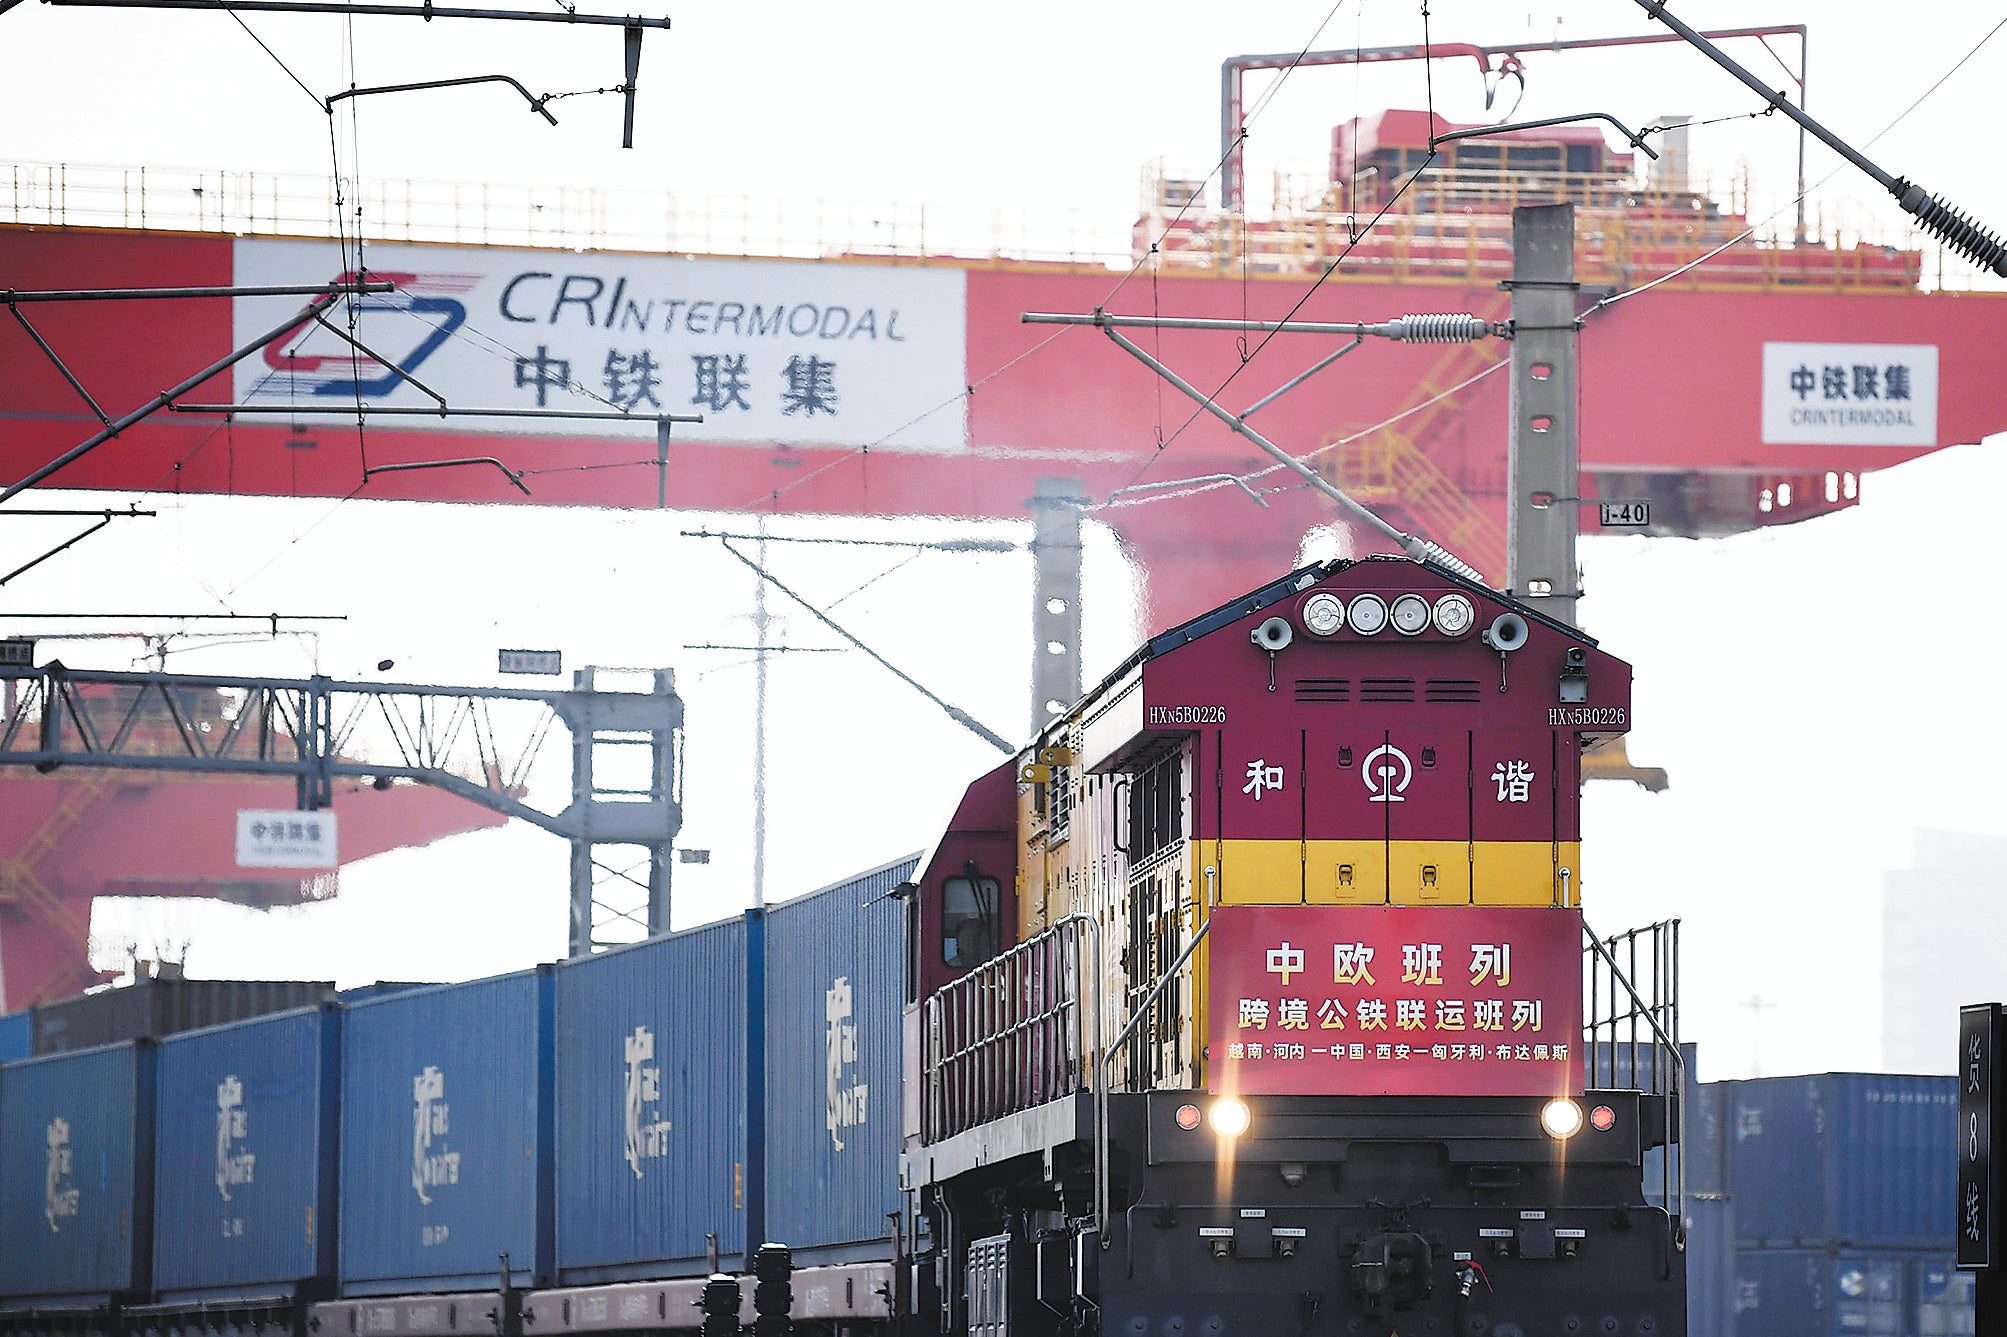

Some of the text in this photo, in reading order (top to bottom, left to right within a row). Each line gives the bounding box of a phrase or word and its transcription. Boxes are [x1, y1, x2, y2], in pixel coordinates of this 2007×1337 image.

[513, 344, 838, 417] 中铁联集
[1790, 365, 1912, 401] 中铁联集
[1242, 758, 1535, 802] 和 谐
[1265, 942, 1511, 987] 中欧班列
[1238, 998, 1543, 1031] 跨境公铁联运班列
